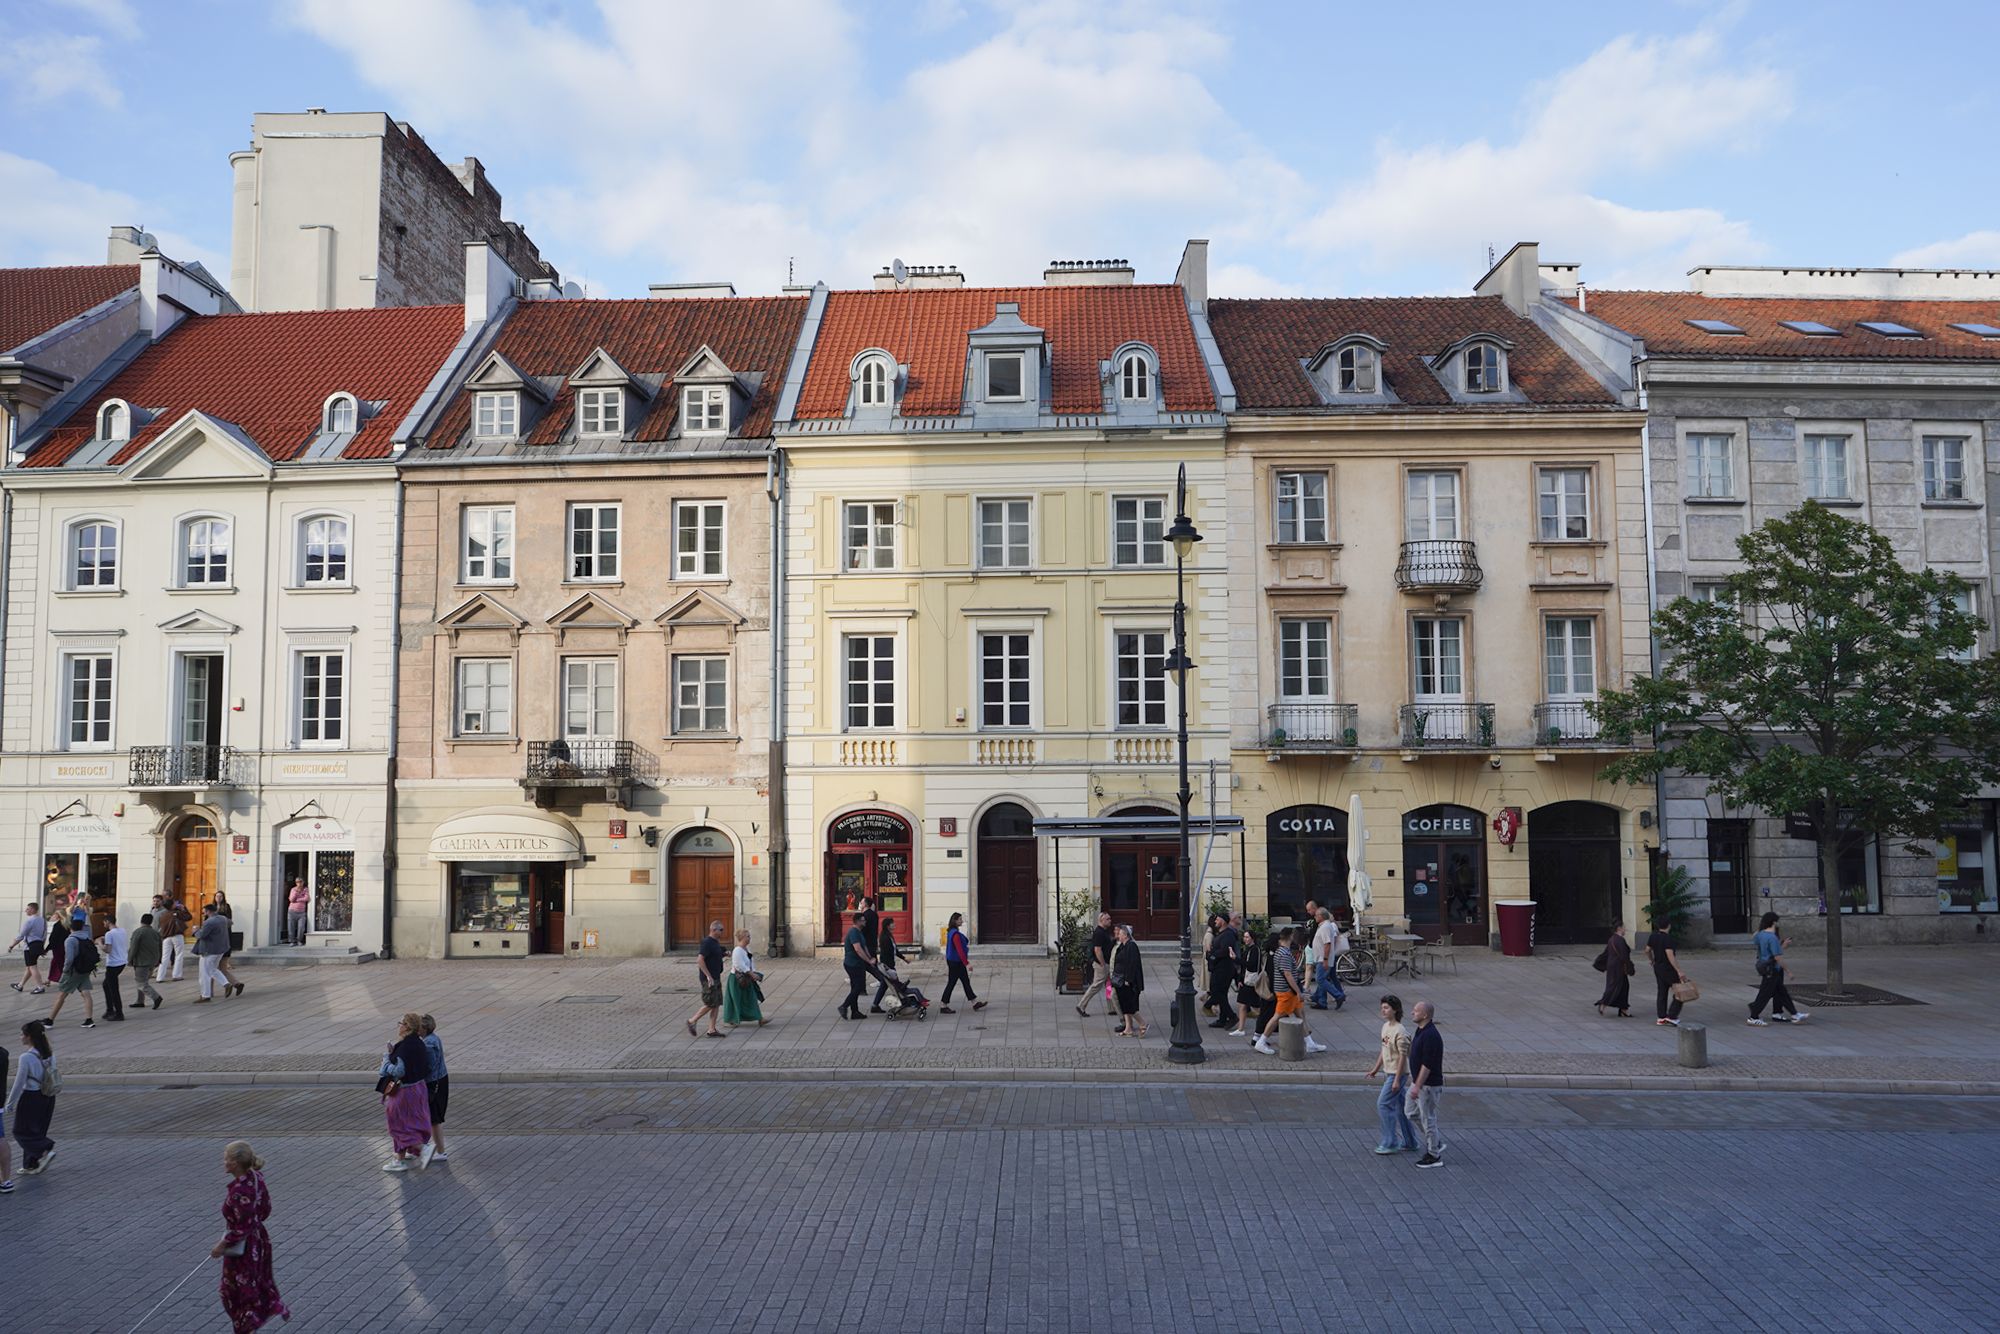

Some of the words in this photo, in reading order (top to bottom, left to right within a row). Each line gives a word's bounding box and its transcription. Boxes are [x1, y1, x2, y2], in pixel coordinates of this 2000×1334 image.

[57, 766, 107, 776] BROCHOCKI
[837, 815, 866, 829] PRACOWNIA
[866, 814, 905, 831] ARTYSTYCZNYCH
[863, 820, 892, 829] STYLOWYCH
[944, 823, 953, 832] 10
[1279, 818, 1335, 833] COSTA
[1408, 818, 1472, 831] COFFEE
[613, 825, 622, 835] 12
[289, 833, 311, 841] INDIA
[313, 833, 345, 841] MARKET
[694, 837, 714, 847] 12
[236, 841, 244, 850] 14
[439, 838, 490, 850] GALERIA
[495, 838, 549, 850] ATTICUS
[878, 863, 908, 871] STYLOWE
